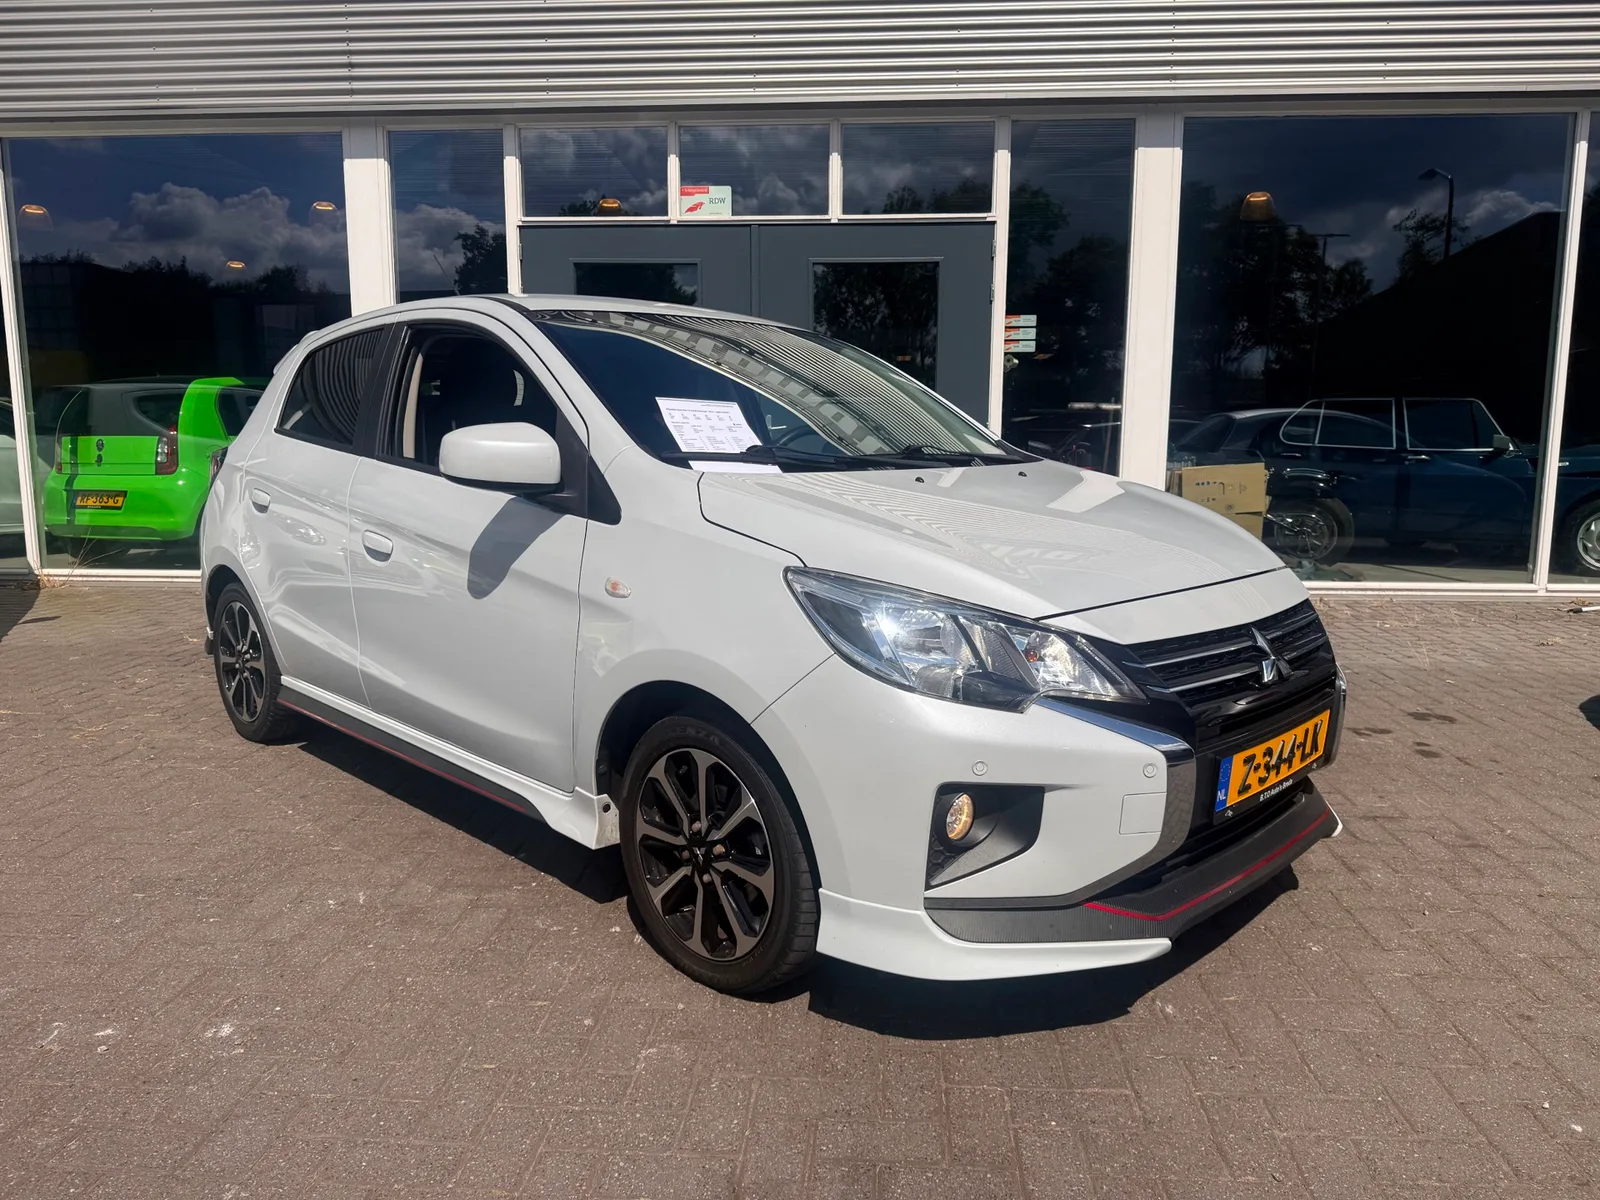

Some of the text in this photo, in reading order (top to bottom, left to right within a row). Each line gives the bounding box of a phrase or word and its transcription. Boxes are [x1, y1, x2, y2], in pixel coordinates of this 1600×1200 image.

[709, 197, 726, 205] RDW
[80, 493, 119, 505] RF-363-G
[1237, 719, 1323, 797] Z-344-LK
[1216, 788, 1227, 802] NL
